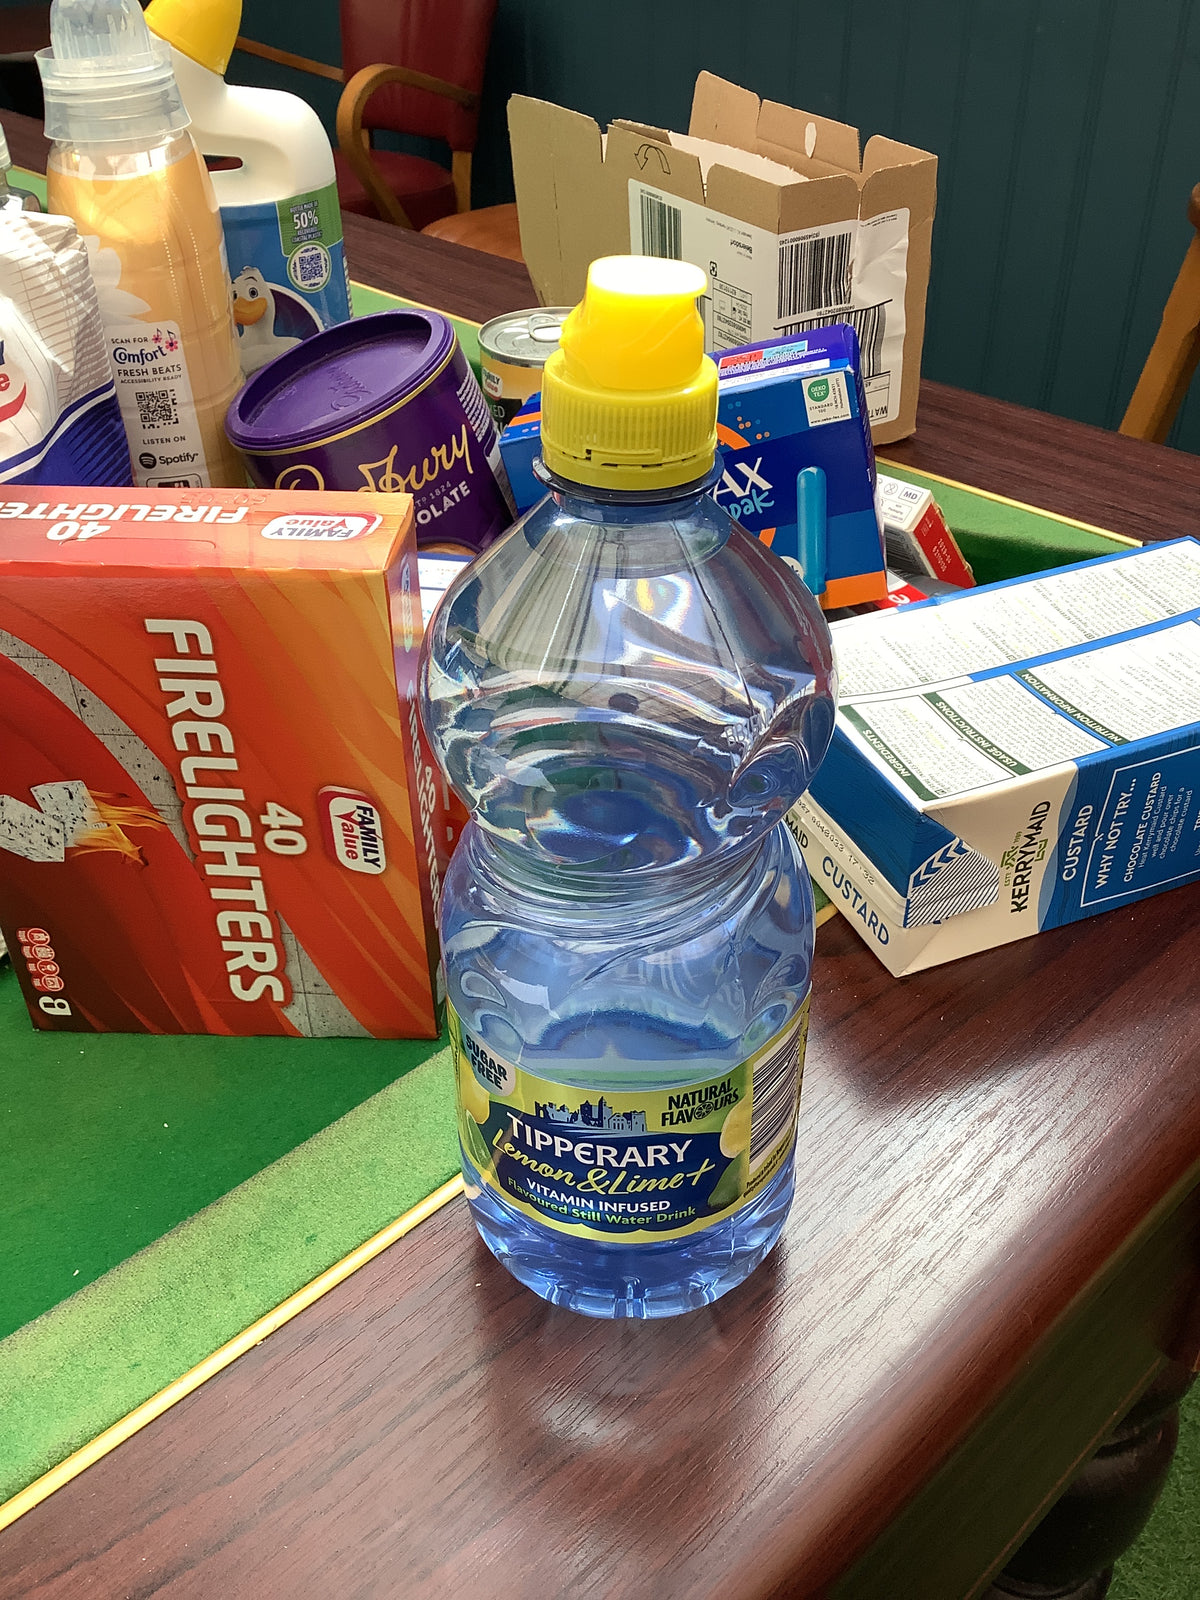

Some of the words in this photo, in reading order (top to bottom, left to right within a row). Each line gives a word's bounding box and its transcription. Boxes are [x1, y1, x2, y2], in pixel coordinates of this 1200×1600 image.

[293, 209, 319, 230] 50%
[112, 345, 168, 365] Comfort
[133, 336, 149, 344] FOR
[117, 368, 149, 377] FRESH
[152, 364, 182, 376] BEATS
[120, 377, 162, 385] ACCESSIBILITY
[162, 374, 182, 382] READY
[810, 384, 827, 393] OEKO
[809, 402, 834, 411] STANDARD
[143, 437, 171, 445] LISTEN
[173, 435, 187, 443] ON
[158, 452, 198, 466] Spotify
[725, 489, 775, 520] pak
[903, 489, 919, 501] MD
[0, 502, 249, 525] FIRELIGHTE
[46, 521, 112, 541] 40
[285, 518, 350, 532] Value
[270, 526, 354, 540] FAMILY
[1021, 673, 1079, 716] INFORMATION
[935, 701, 992, 749] INSTRUCTIONS
[1073, 712, 1123, 743] NUTRITION
[860, 729, 911, 778] INGREDIENTS
[986, 746, 1018, 767] USAGE
[424, 766, 436, 814] 40
[1174, 794, 1183, 808] for
[144, 618, 285, 1003] FIRELIGHTERS
[259, 801, 308, 856] 40
[1123, 822, 1148, 882] CHOCOLATE
[1141, 772, 1162, 821] CUSTARD
[1138, 852, 1148, 868] Heat
[1143, 815, 1159, 853] Kerrymaid
[1153, 785, 1167, 815] Custard
[1151, 844, 1160, 858] well
[1161, 813, 1169, 829] pour
[1165, 794, 1174, 810] over
[1169, 807, 1180, 826] chips
[1170, 818, 1185, 853] chocolate
[1181, 790, 1193, 818] custard
[333, 808, 360, 861] Value
[354, 804, 382, 868] FAMILY
[1062, 804, 1094, 881] CUSTARD
[1159, 825, 1175, 859] chocolate
[1010, 801, 1051, 914] KERRYMAID
[1094, 855, 1114, 889] WHY
[1104, 821, 1124, 851] NOT
[822, 855, 890, 946] CUSTARD
[466, 1034, 508, 1081] SUGAR
[471, 1053, 503, 1091] FREE
[668, 1078, 734, 1111] NATURAL
[492, 1128, 577, 1187] Lemon
[507, 1111, 692, 1168] TIPPERARY
[507, 1176, 569, 1216] Flavoured
[571, 1208, 601, 1223] Still
[606, 1213, 653, 1226] Water
[656, 1206, 697, 1223] Drink
[526, 1177, 595, 1210] VITAMIN
[598, 1200, 671, 1213] INFUSED
